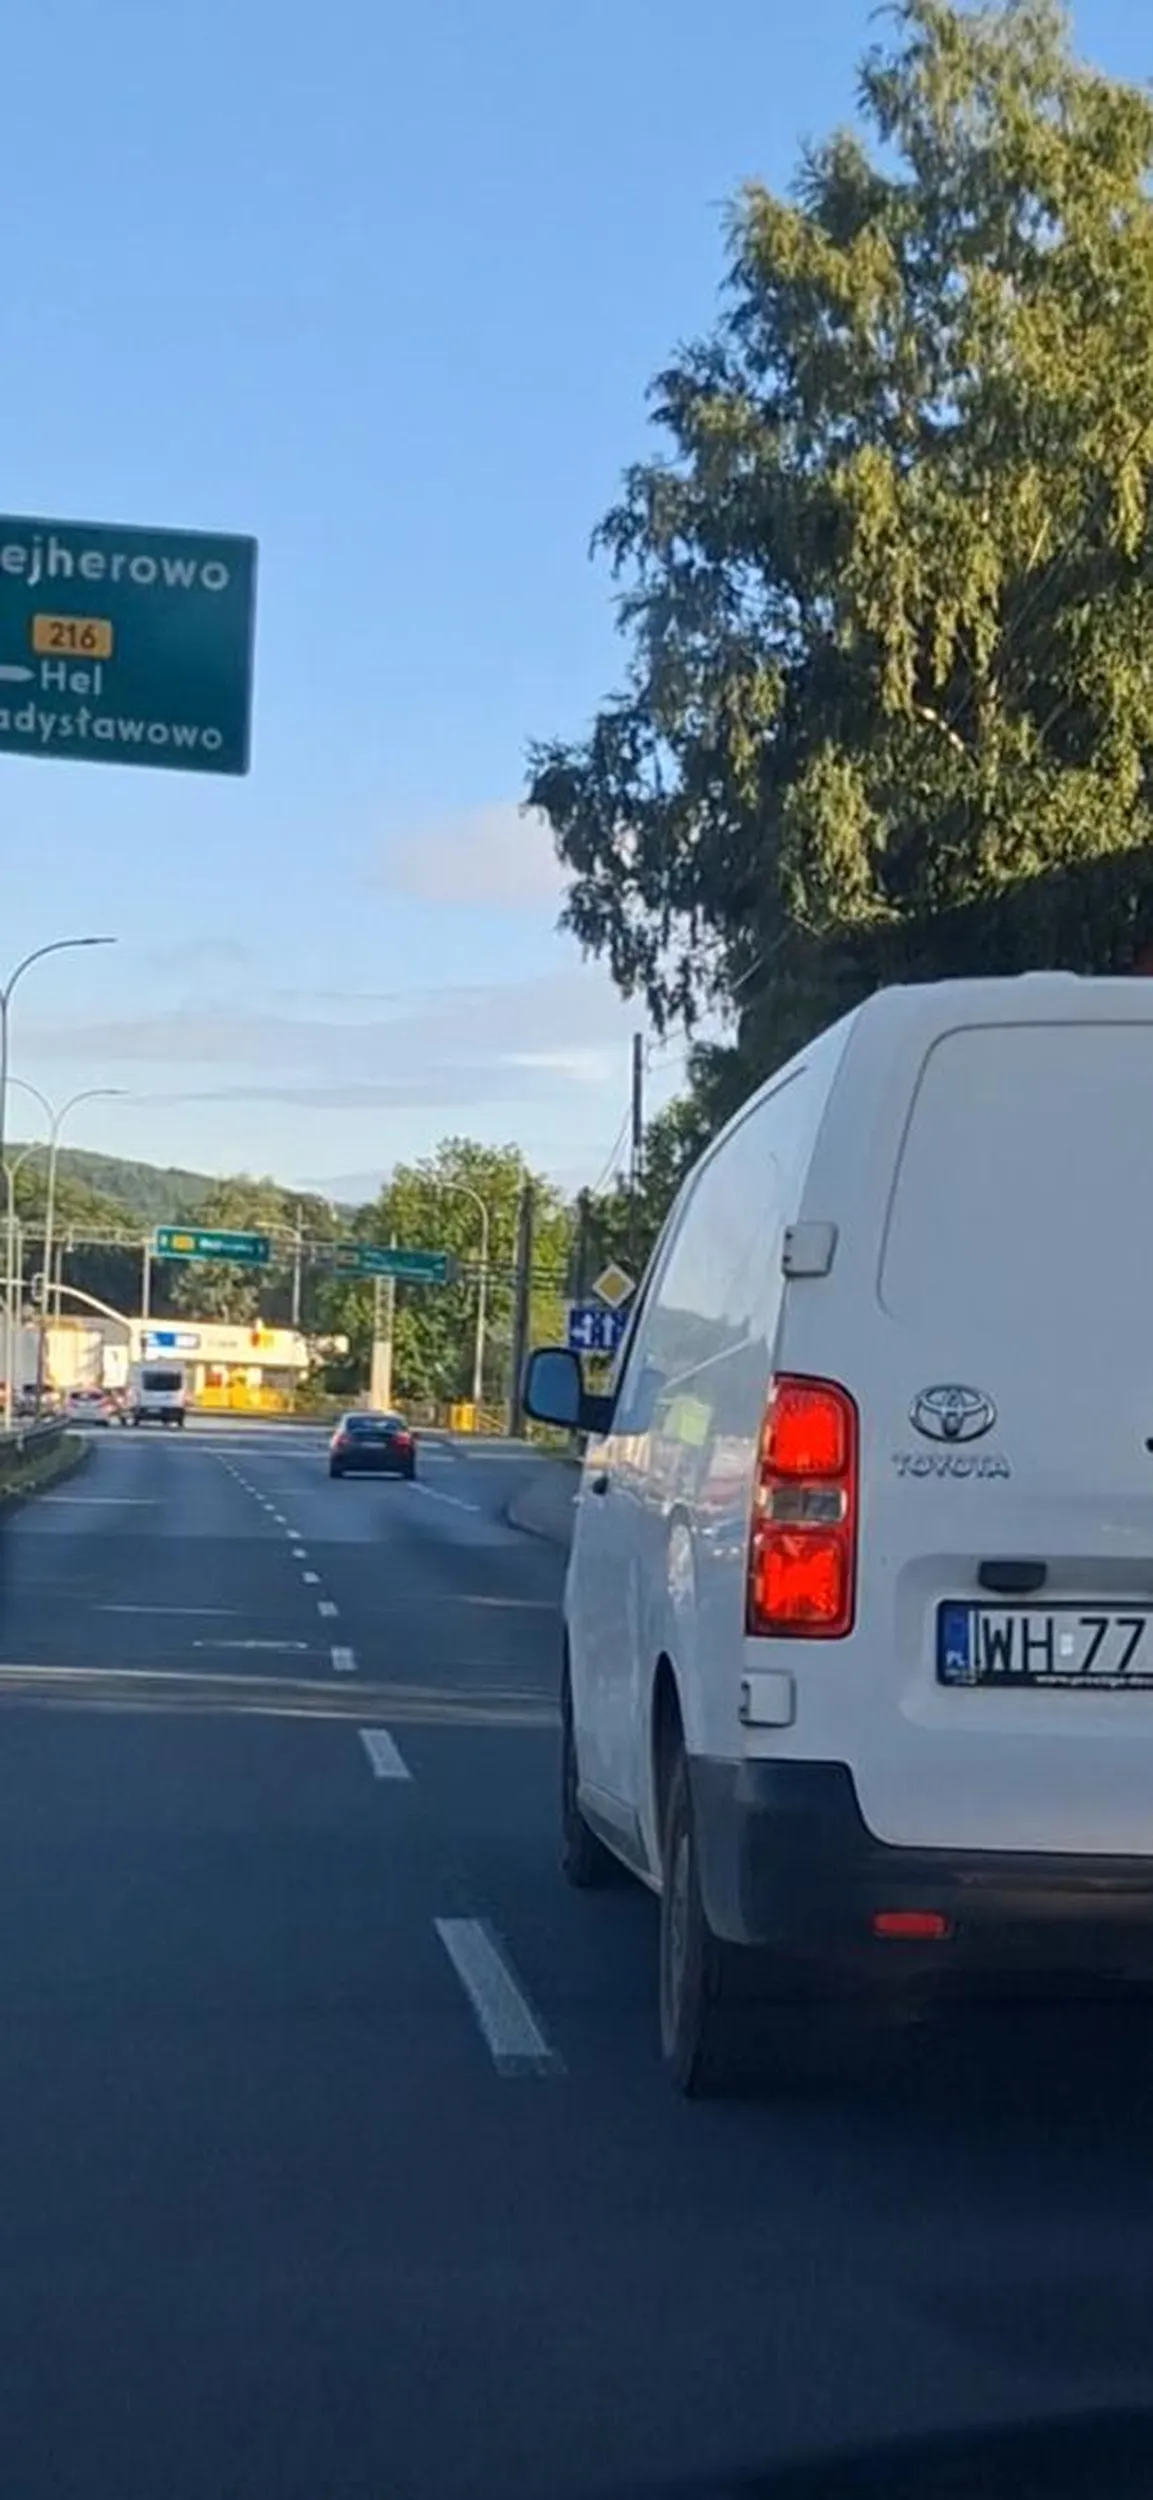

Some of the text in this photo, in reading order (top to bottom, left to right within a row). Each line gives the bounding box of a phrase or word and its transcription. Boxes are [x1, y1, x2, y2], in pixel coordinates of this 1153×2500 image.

[0, 536, 229, 590] ejherowo
[50, 622, 97, 649] 216
[40, 660, 102, 696] Hel
[892, 1455, 1011, 1479] TOYOTA
[982, 1617, 1146, 1671] WH 77
